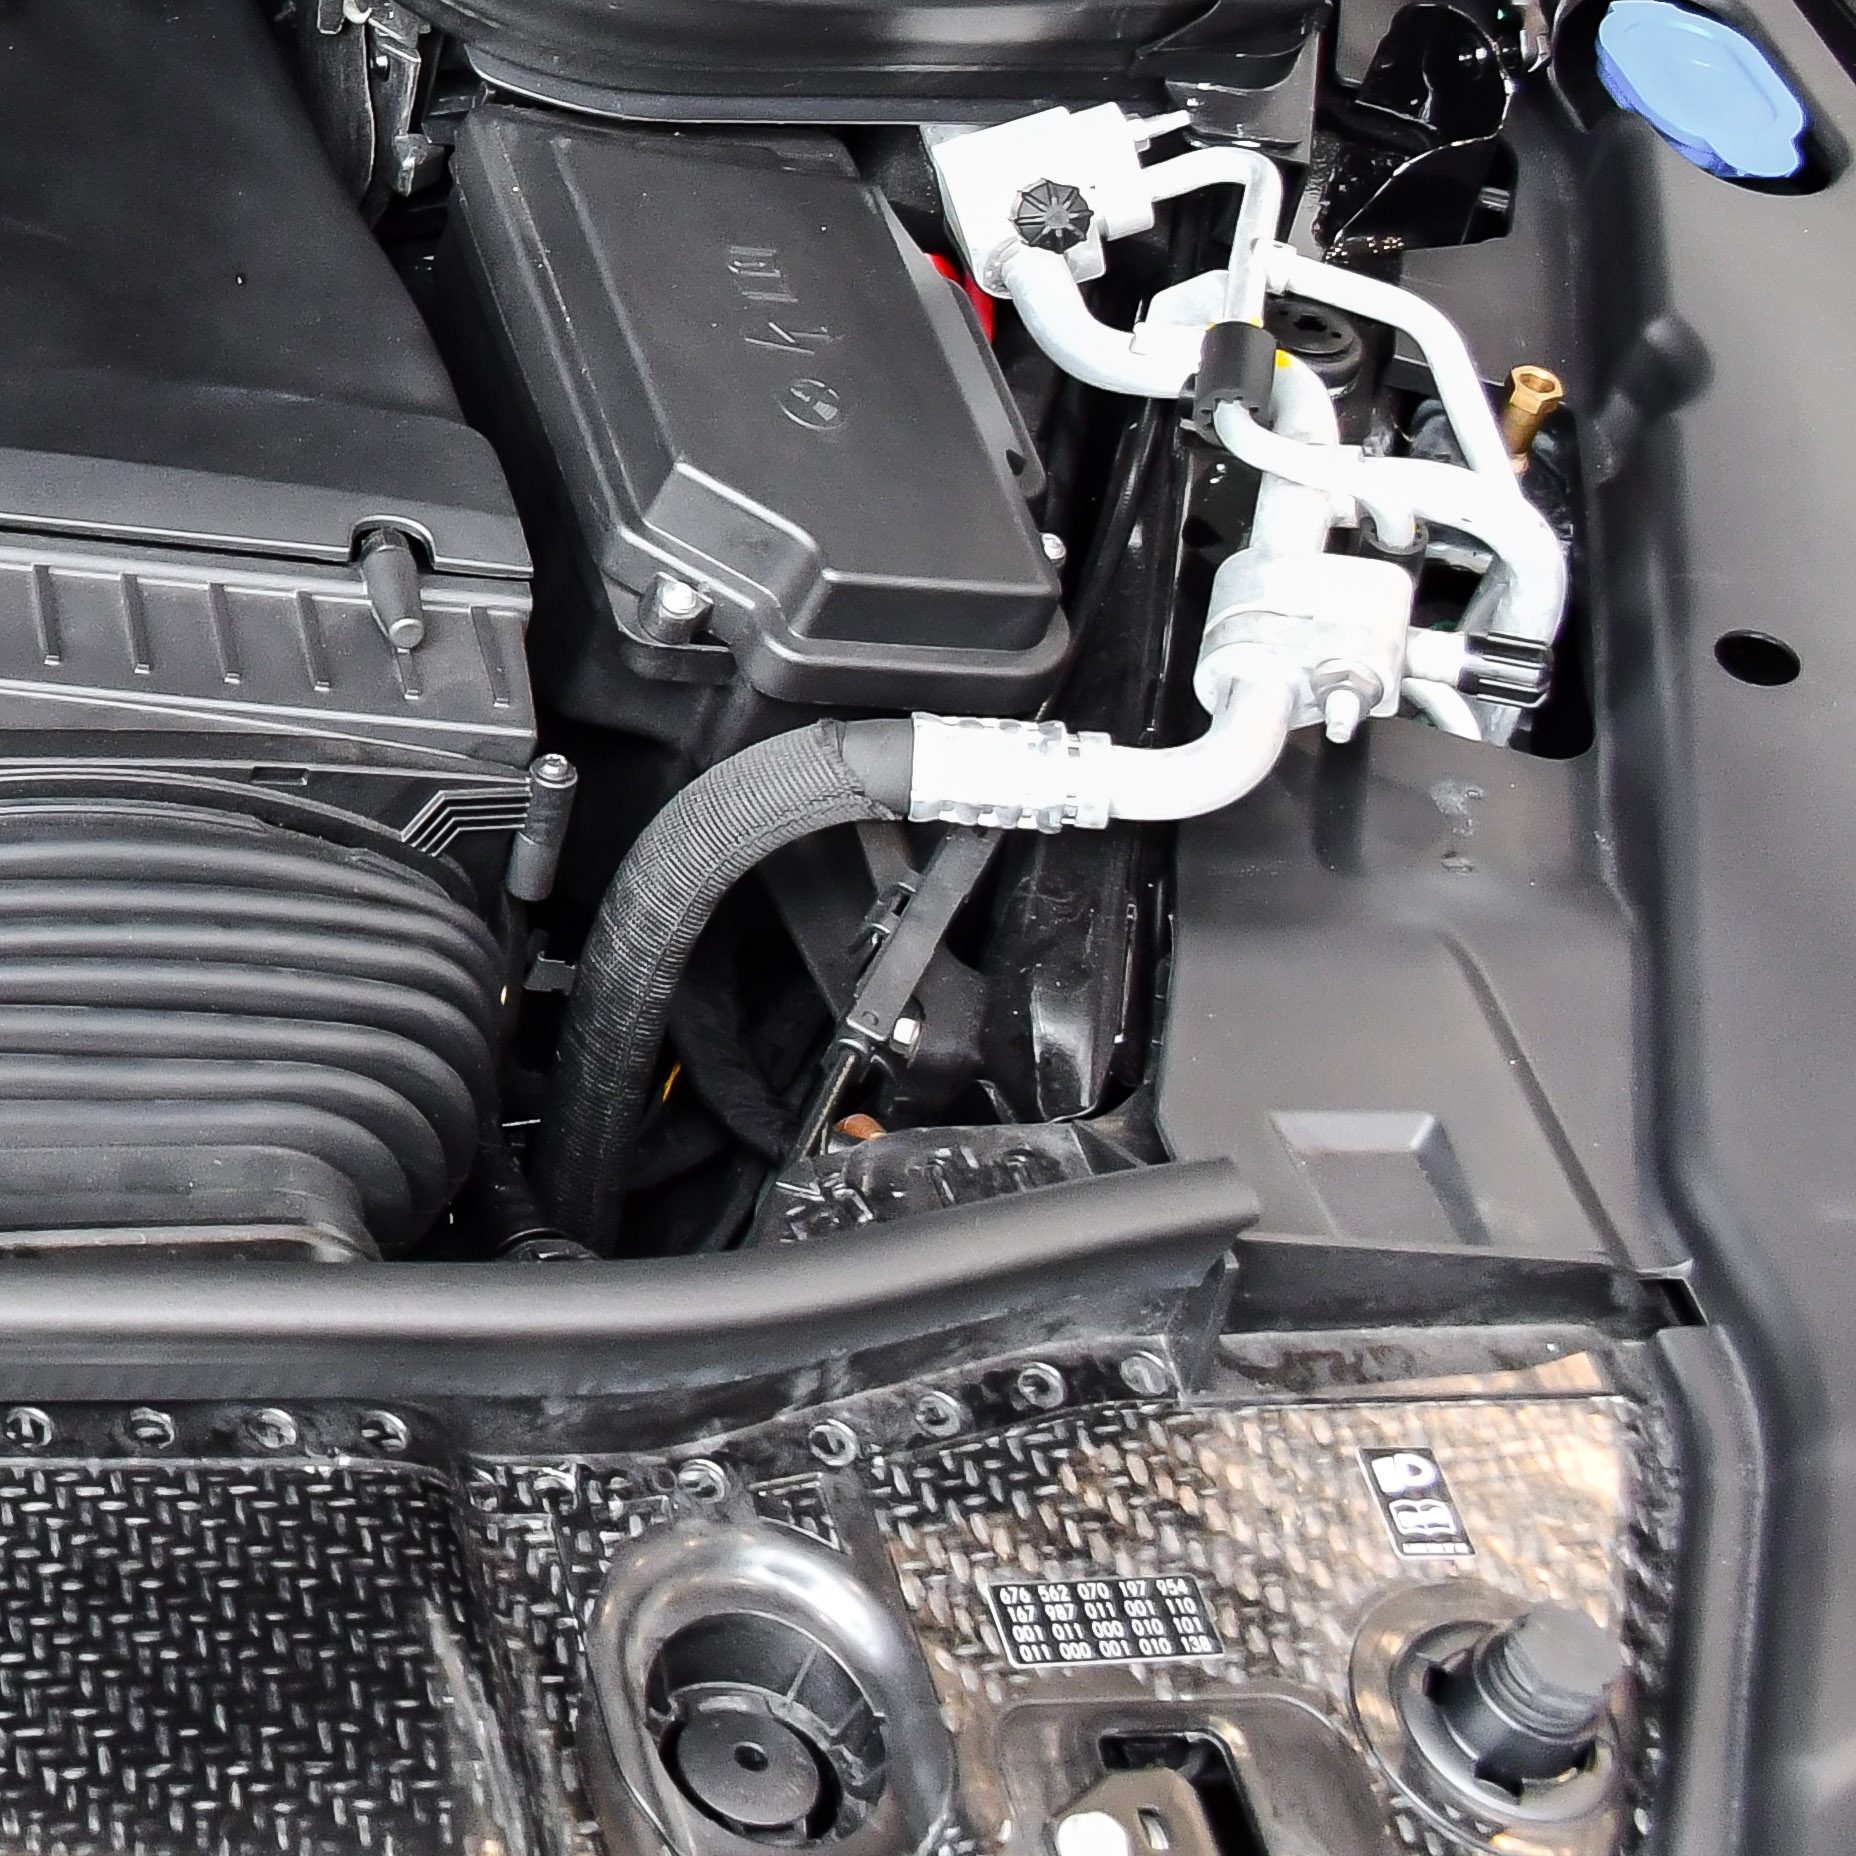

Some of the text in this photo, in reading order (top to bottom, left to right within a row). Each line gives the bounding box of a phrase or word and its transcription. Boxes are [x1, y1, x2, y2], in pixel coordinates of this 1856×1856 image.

[1000, 1586, 1031, 1605] 676
[1038, 1584, 1070, 1602] 562
[1077, 1583, 1109, 1600] 070
[1119, 1580, 1146, 1597] 197
[1007, 1597, 1196, 1623] 167 987 011 001 110
[1013, 1617, 1203, 1643] 001 011 000 010 101
[1019, 1644, 1051, 1662] 011
[1059, 1642, 1091, 1660] 000
[1099, 1640, 1131, 1658] 001
[1139, 1638, 1172, 1655] 010
